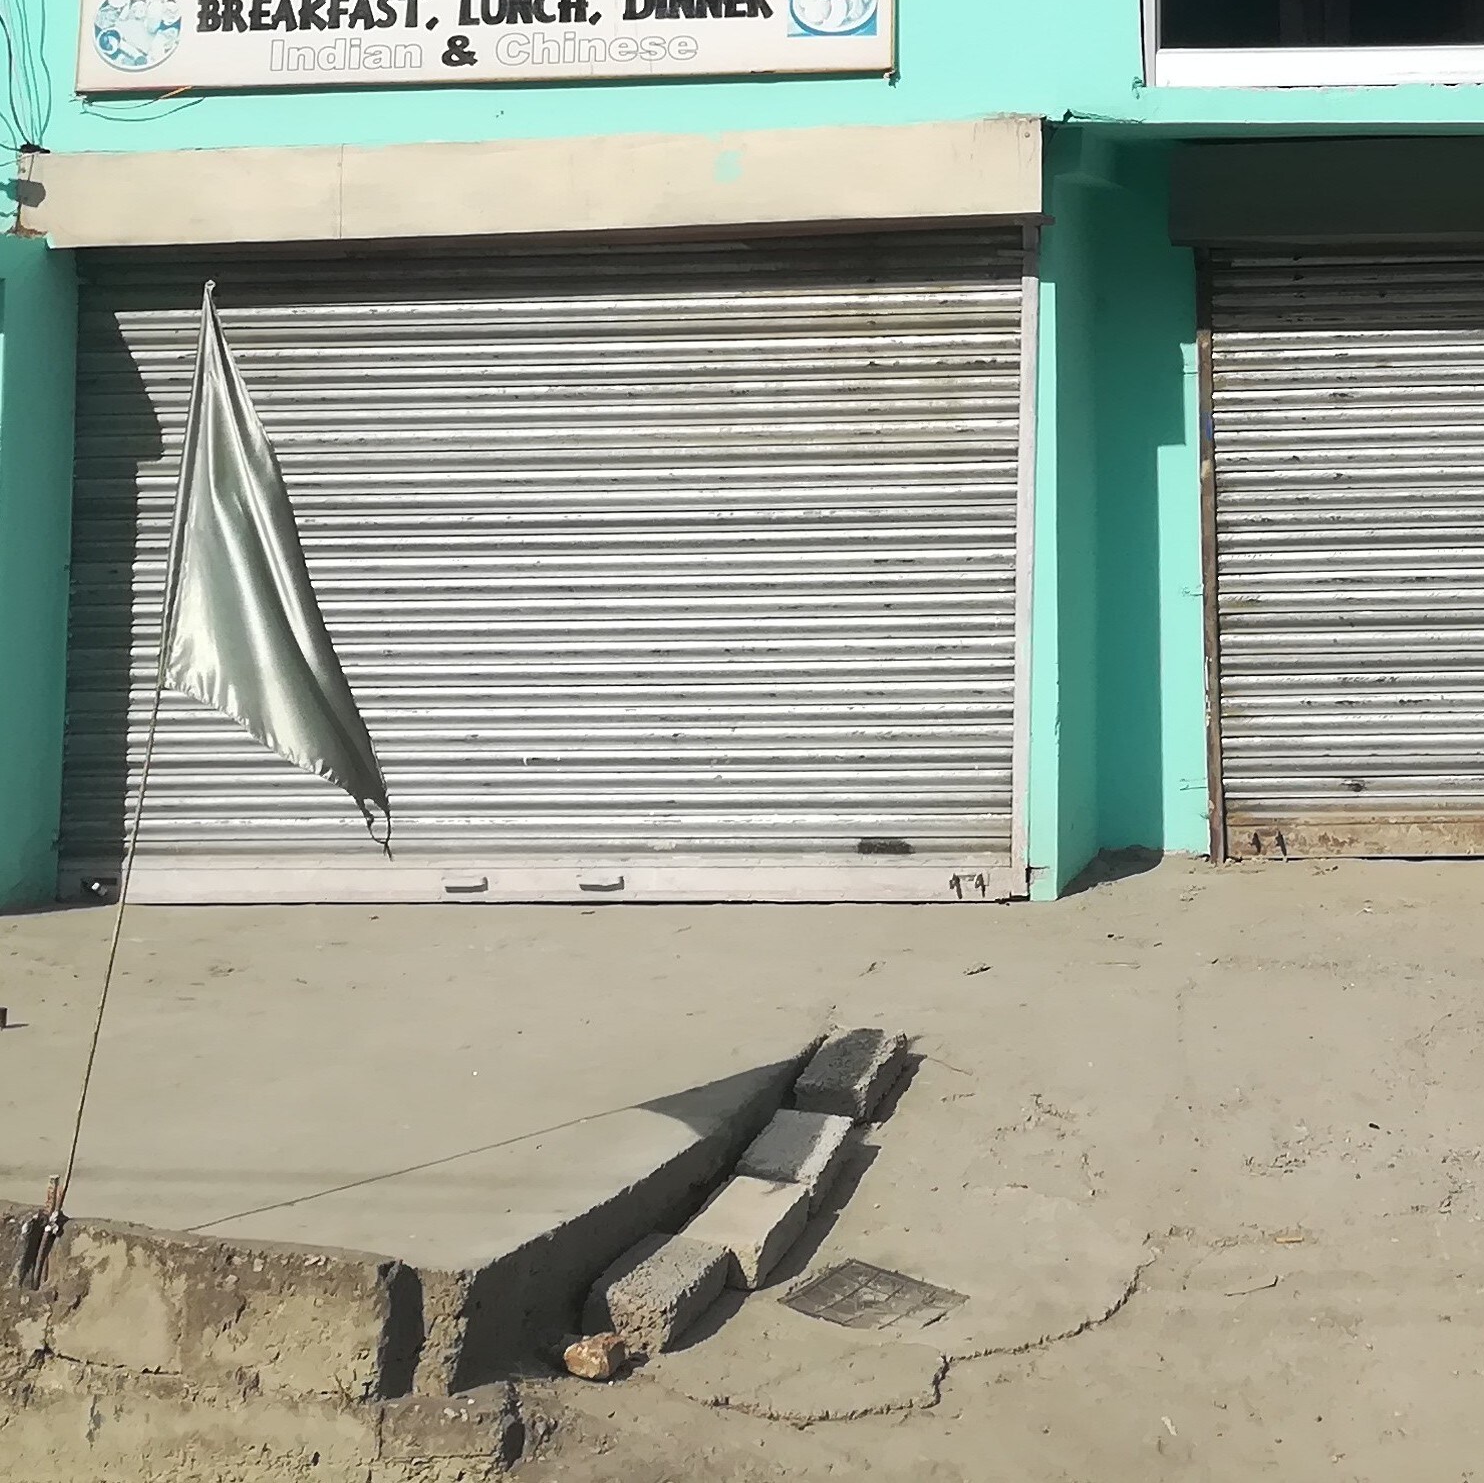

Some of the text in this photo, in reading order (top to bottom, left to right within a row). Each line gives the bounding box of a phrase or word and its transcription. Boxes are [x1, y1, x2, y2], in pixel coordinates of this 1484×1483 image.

[269, 30, 699, 72] Indian & Chinese
